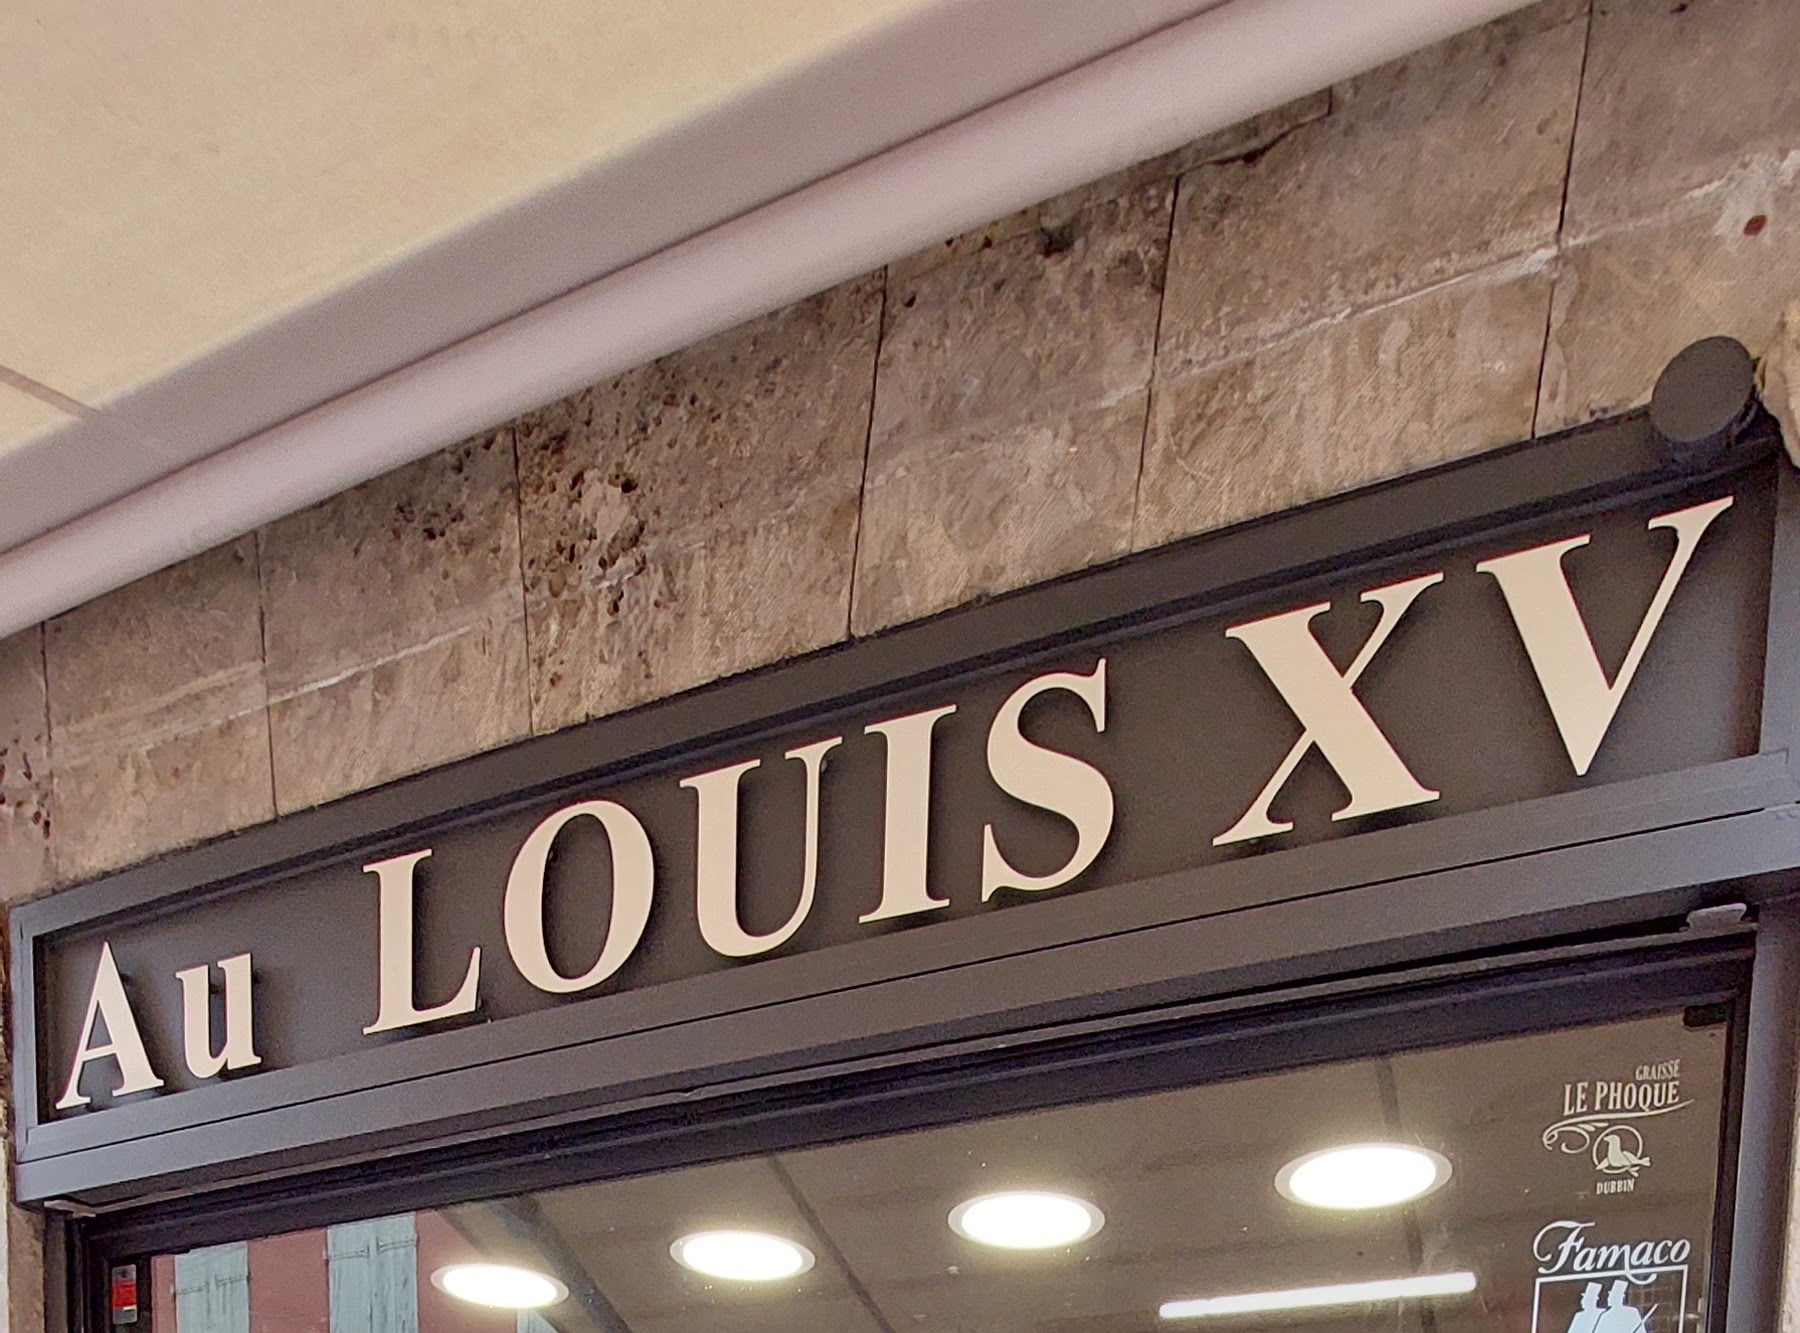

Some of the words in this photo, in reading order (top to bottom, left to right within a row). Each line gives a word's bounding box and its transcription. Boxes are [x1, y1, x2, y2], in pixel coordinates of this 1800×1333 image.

[55, 940, 262, 1109] Au
[363, 657, 1114, 1034] LOUIS
[1212, 496, 1734, 846] XV
[1635, 1059, 1681, 1081] GRAISSE
[1563, 1081, 1588, 1116] LE
[1594, 1081, 1680, 1112] PHOQUE
[1596, 1178, 1635, 1195] DUBBIN
[1533, 1220, 1690, 1284] Famaco
